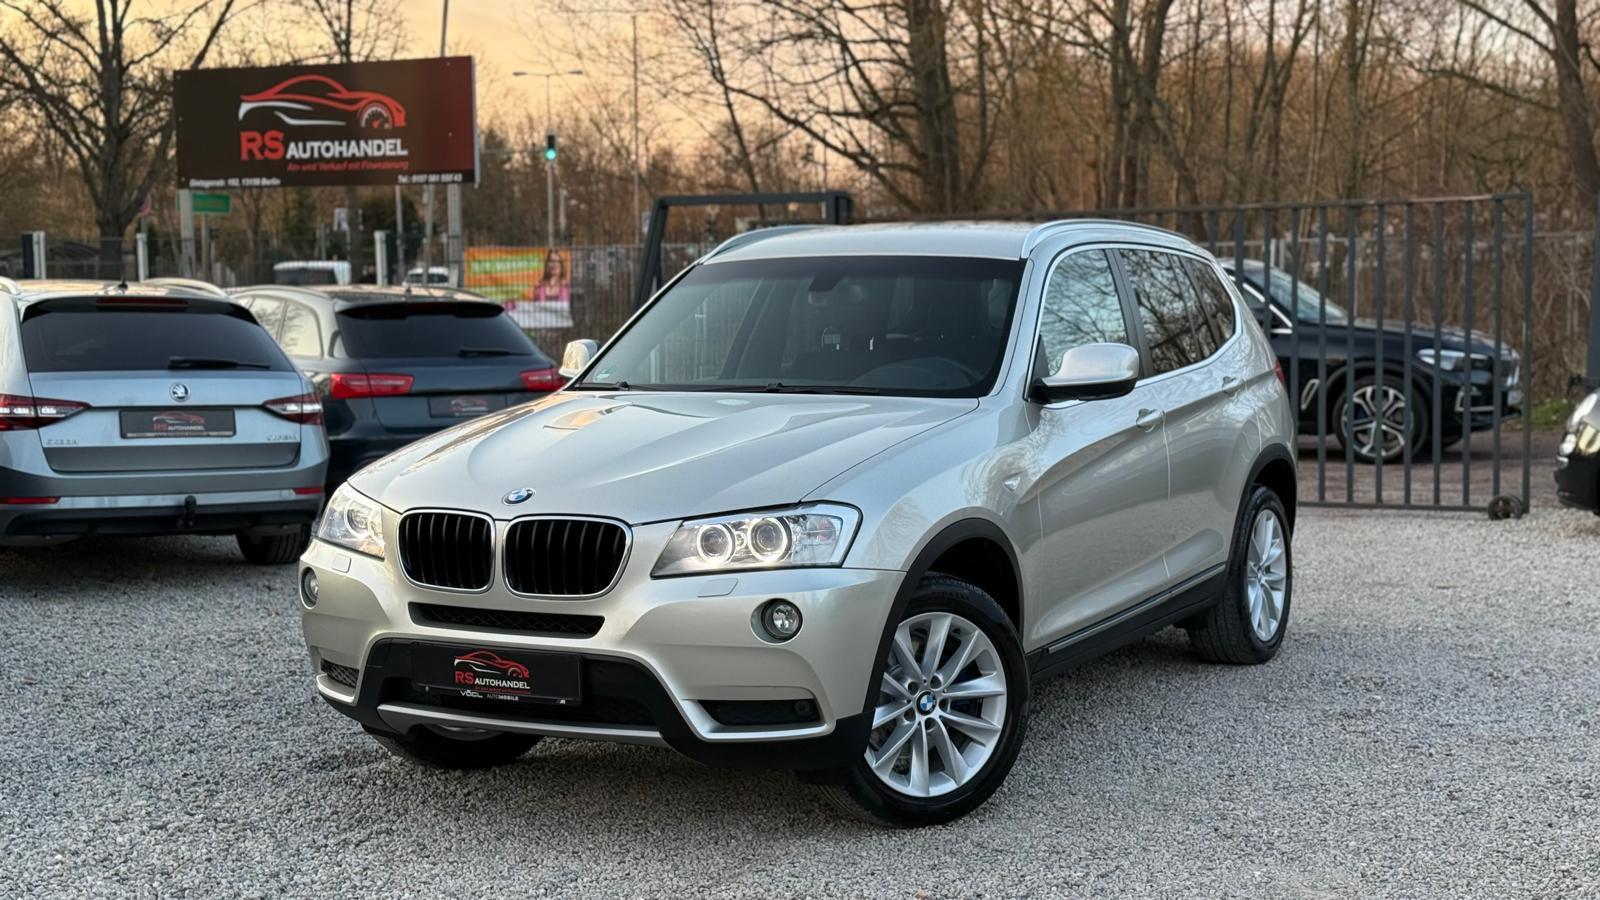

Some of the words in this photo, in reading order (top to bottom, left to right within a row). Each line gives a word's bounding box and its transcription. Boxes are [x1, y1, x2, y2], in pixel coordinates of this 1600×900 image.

[239, 130, 285, 161] RS
[285, 138, 408, 160] AUTOHANDEL
[455, 671, 474, 685] RS
[475, 678, 531, 690] AUTOHANDEL
